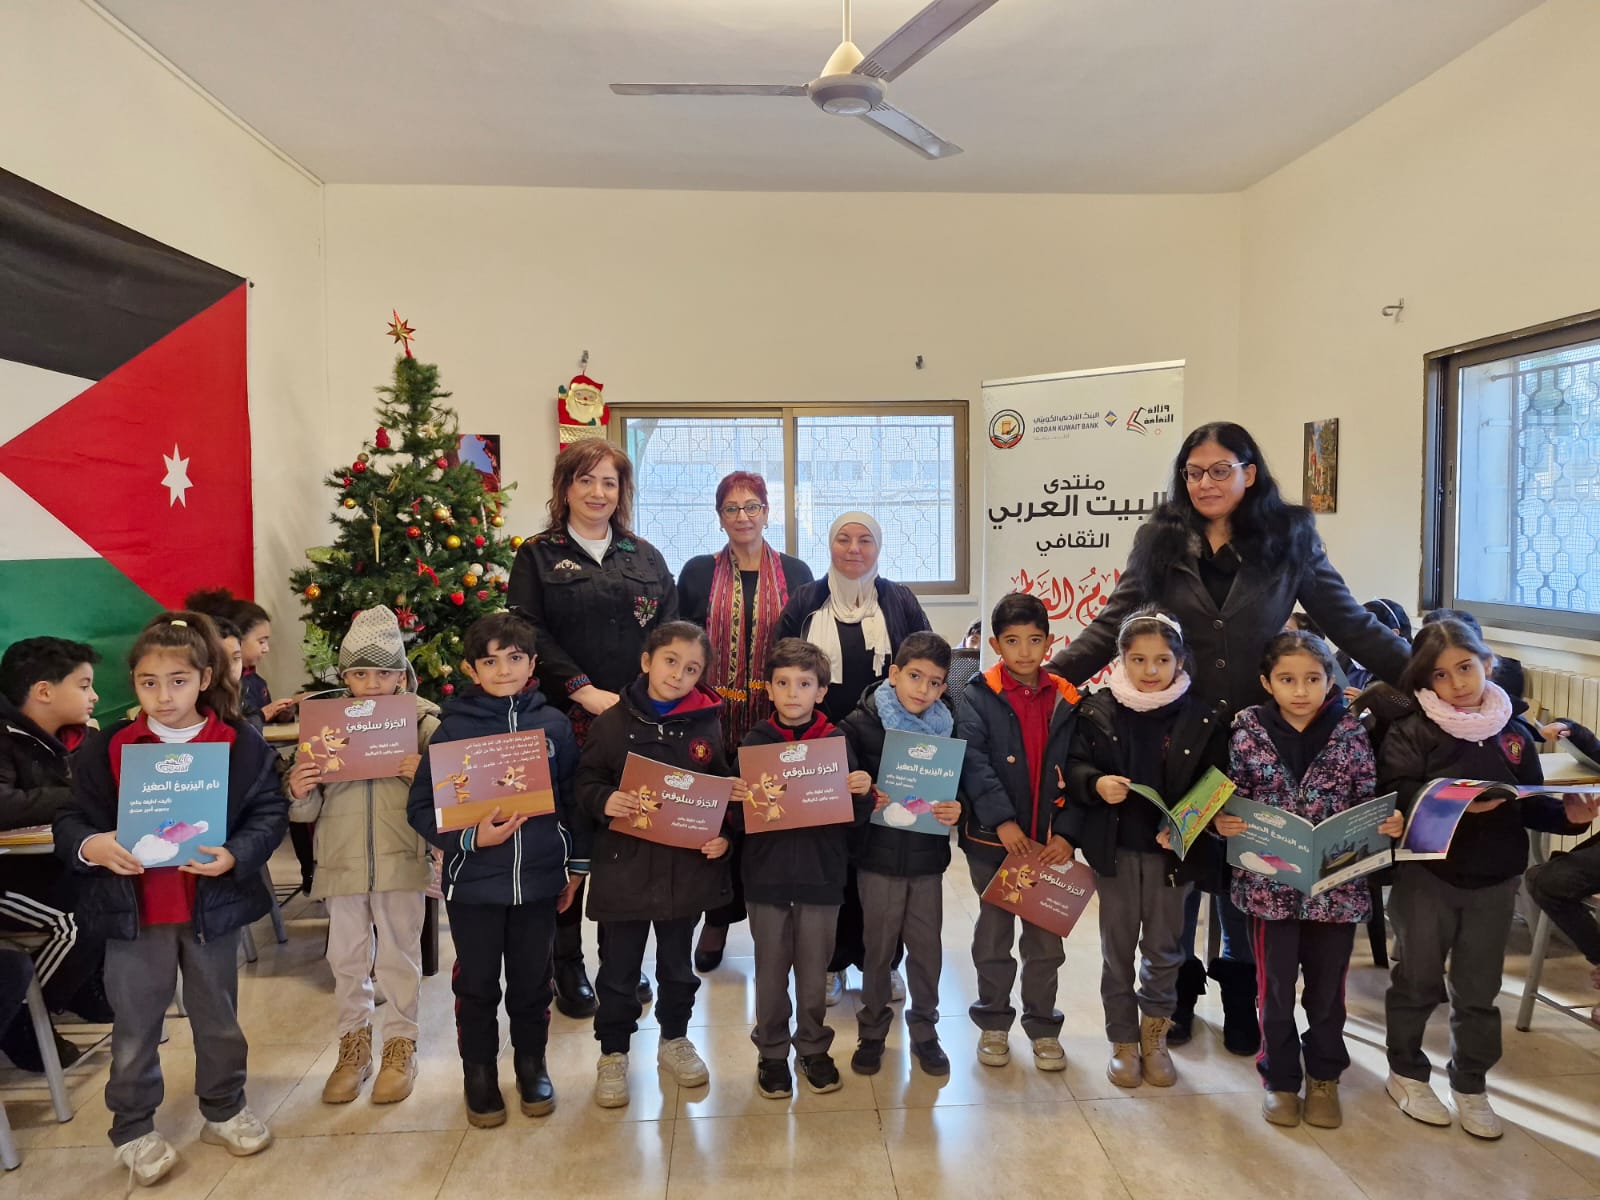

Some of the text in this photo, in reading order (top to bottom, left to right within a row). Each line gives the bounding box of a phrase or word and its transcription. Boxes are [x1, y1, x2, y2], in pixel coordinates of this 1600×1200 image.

[1033, 422, 1099, 433] JORDAN KUWAIT BANK
[1043, 474, 1105, 494] منتدى
[988, 495, 1078, 530] العربي
[1036, 530, 1110, 557] الثقافي
